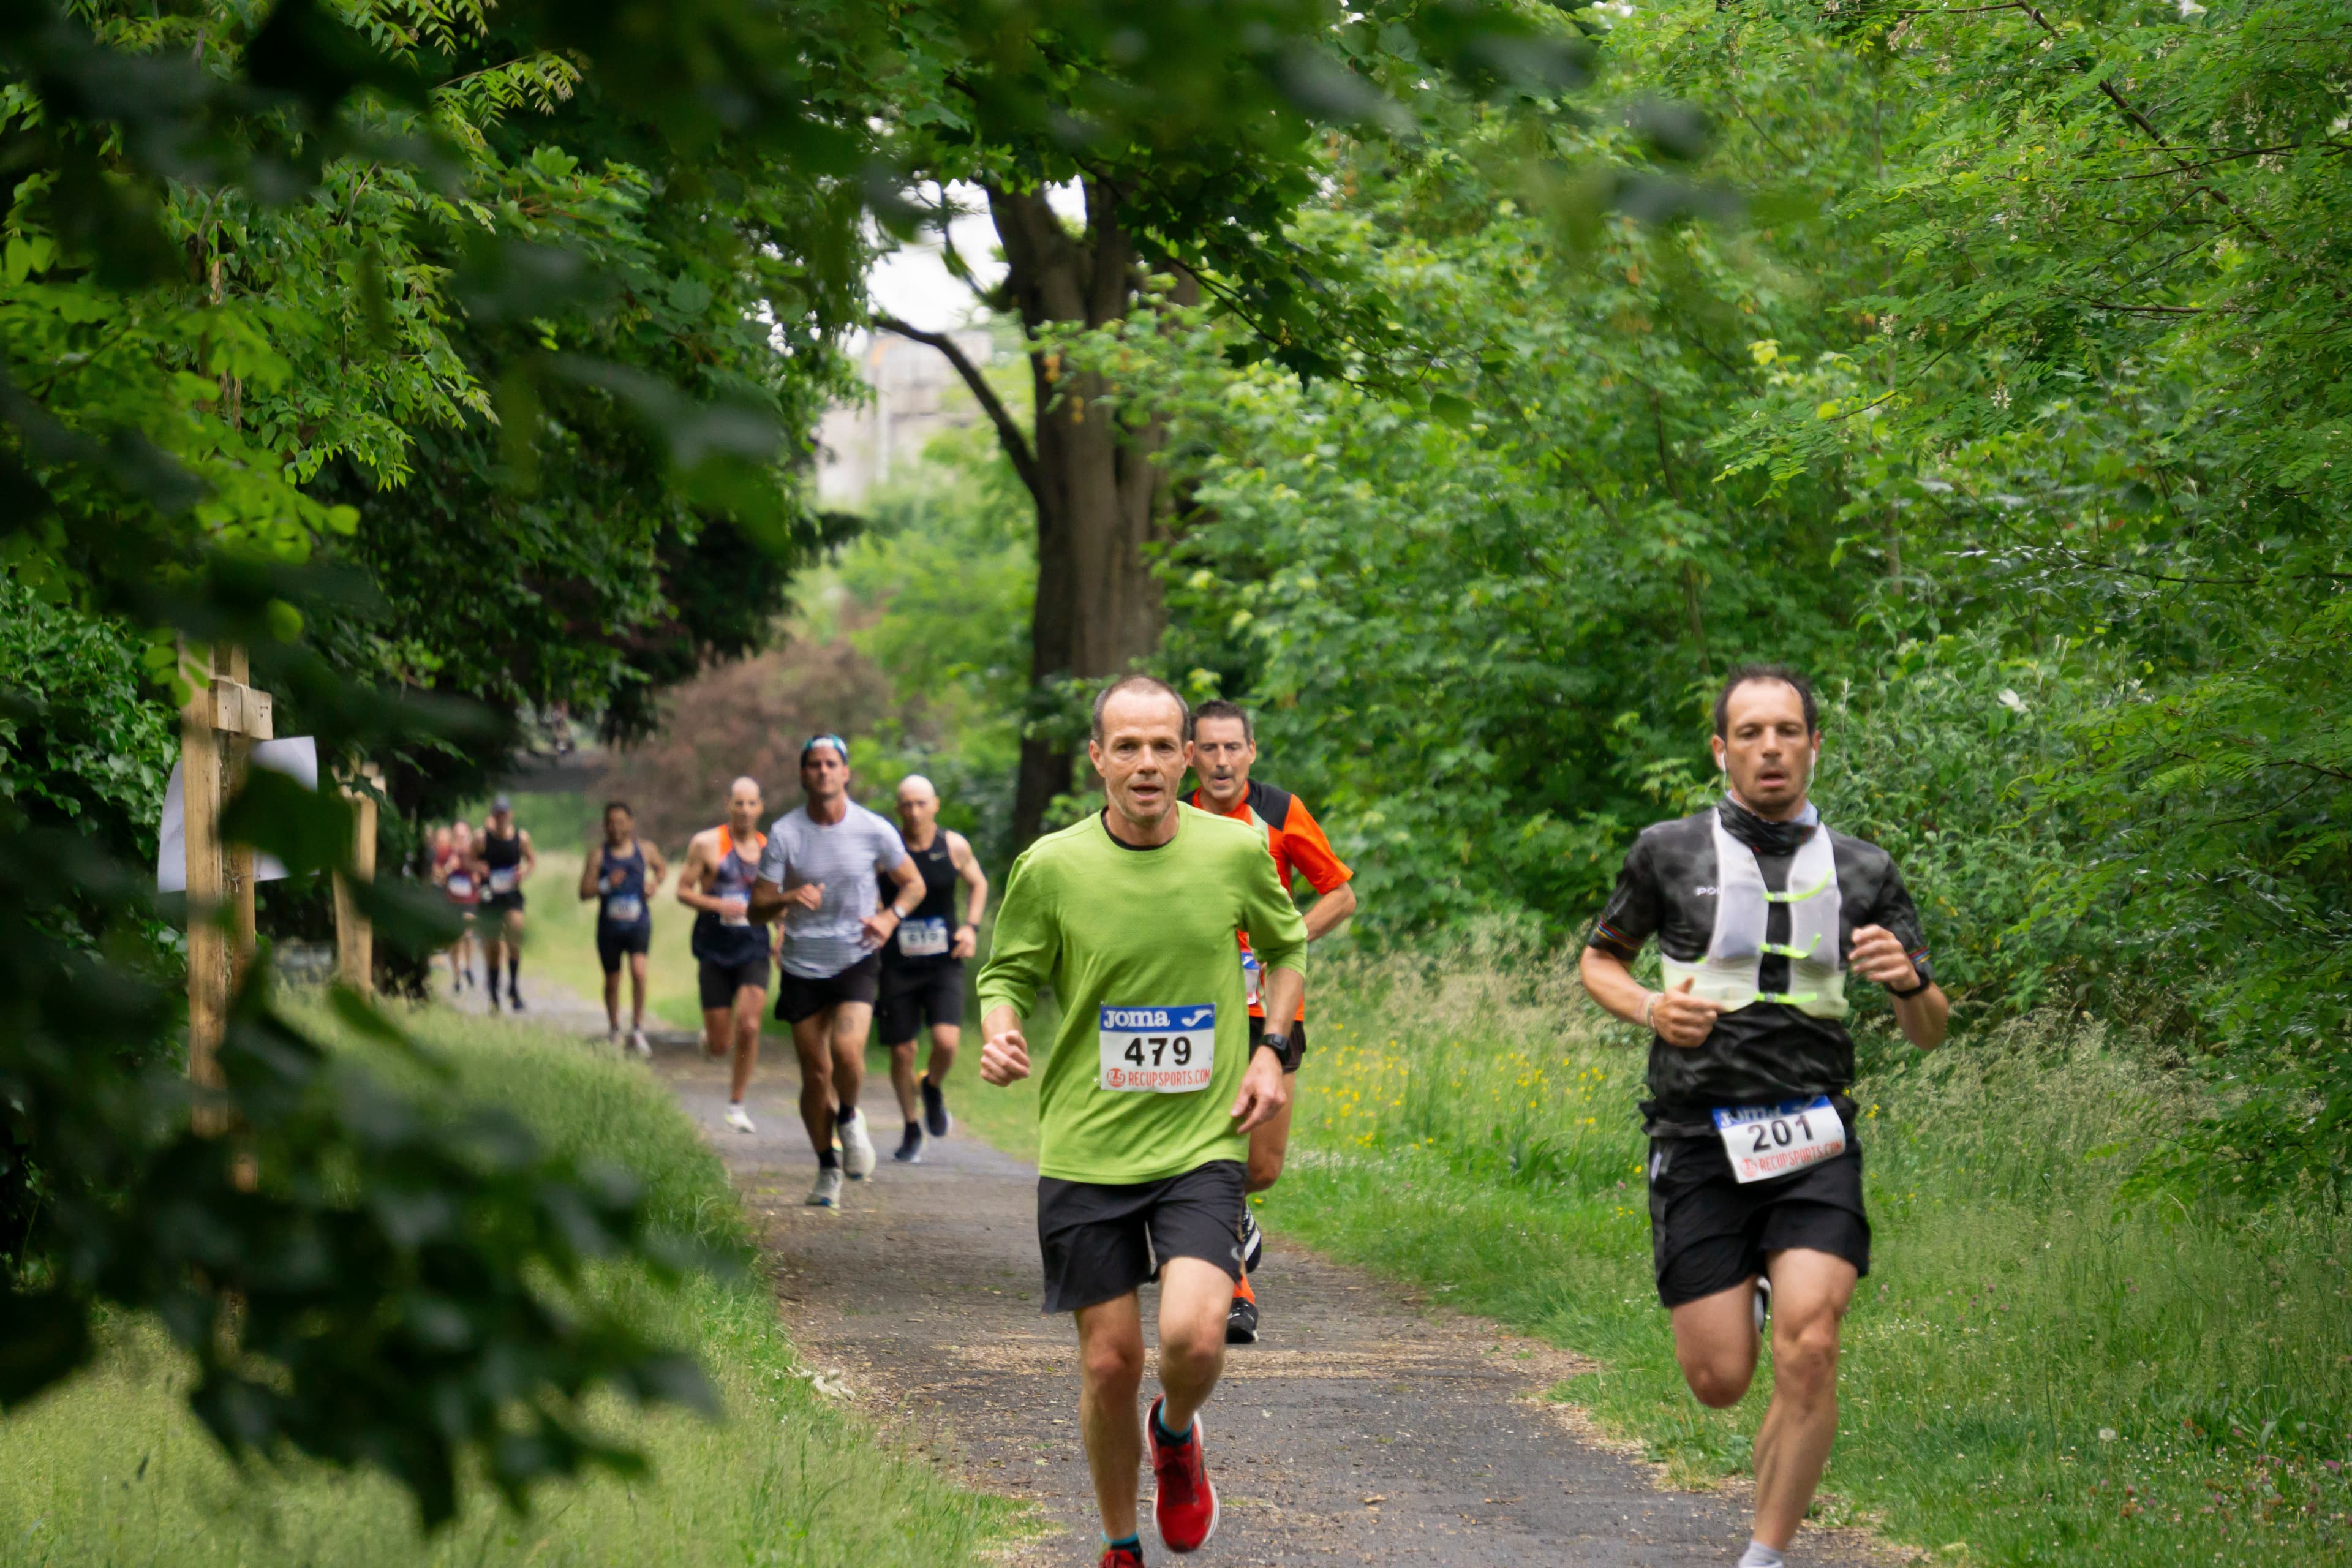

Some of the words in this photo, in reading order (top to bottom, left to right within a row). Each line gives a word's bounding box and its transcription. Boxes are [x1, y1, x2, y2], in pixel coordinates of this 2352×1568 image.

[1125, 1036, 1192, 1066] 479
[1128, 1068, 1210, 1087] RECUPSPORTS.COM
[1748, 1115, 1814, 1153] 201
